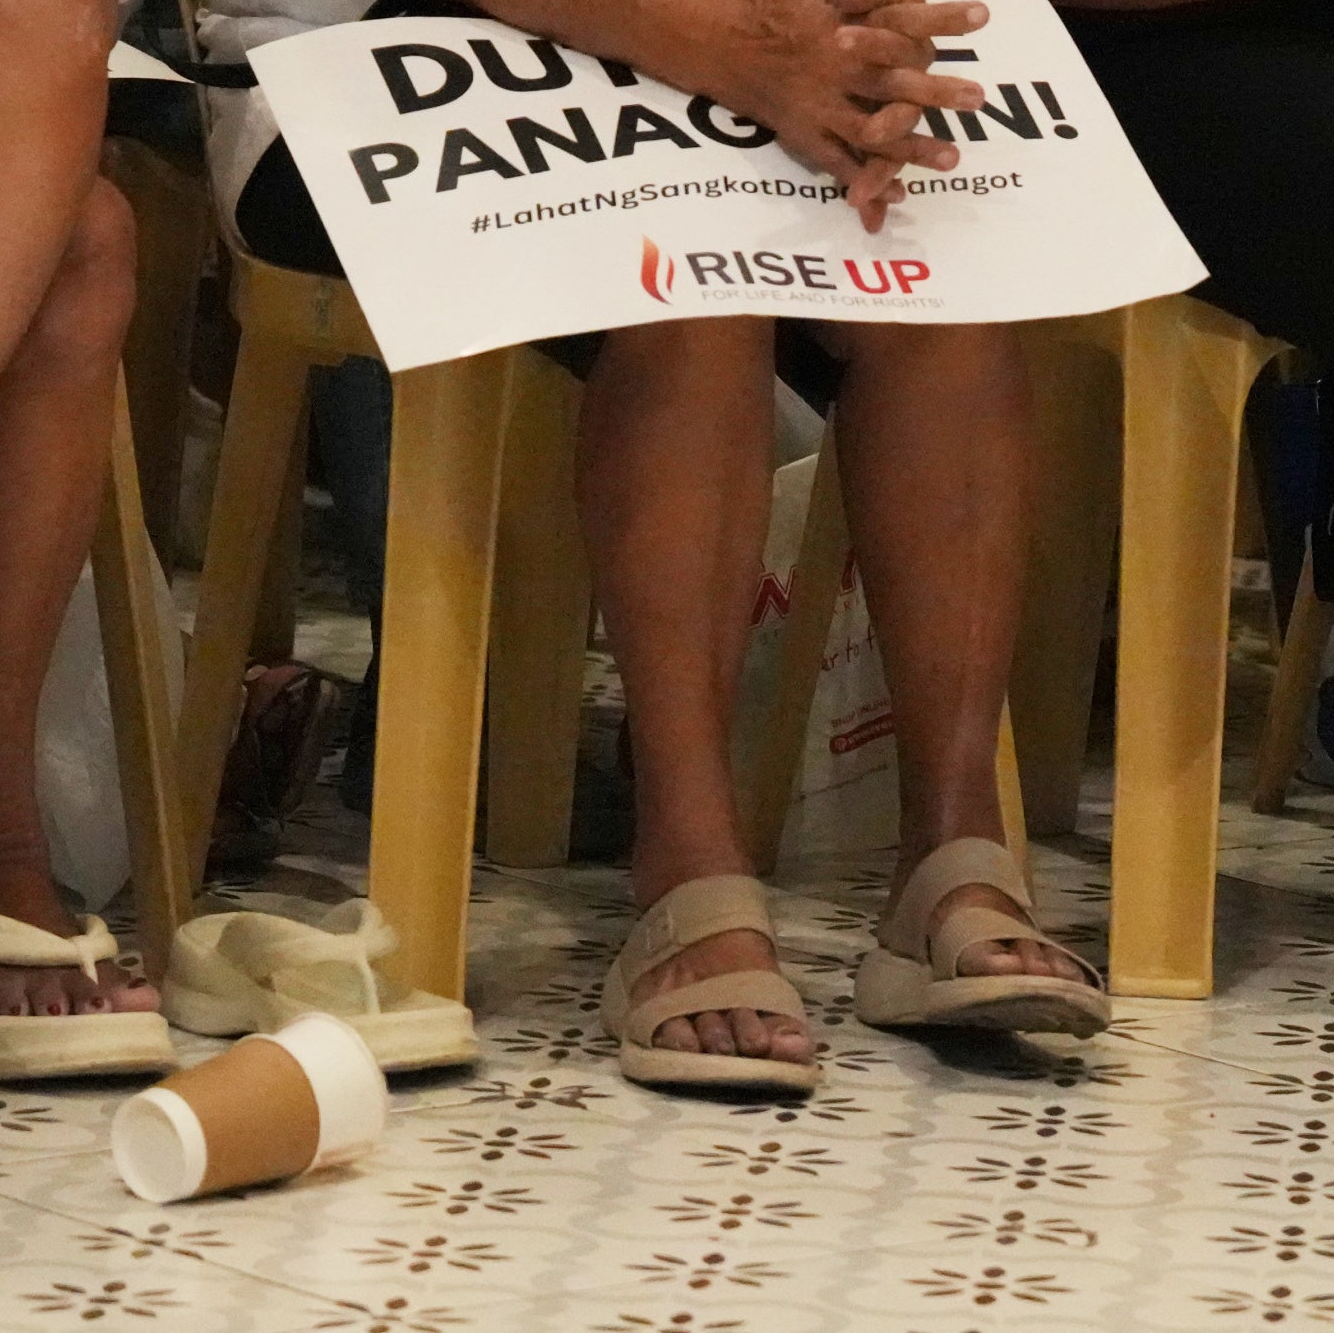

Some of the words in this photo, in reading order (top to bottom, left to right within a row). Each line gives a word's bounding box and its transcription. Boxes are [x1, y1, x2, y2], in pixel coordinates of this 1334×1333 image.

[685, 250, 838, 290] RISE
[842, 258, 931, 294] UP
[701, 288, 739, 302] FOR
[745, 289, 782, 302] LIFE
[789, 292, 827, 305] AND
[831, 294, 868, 307] FOR
